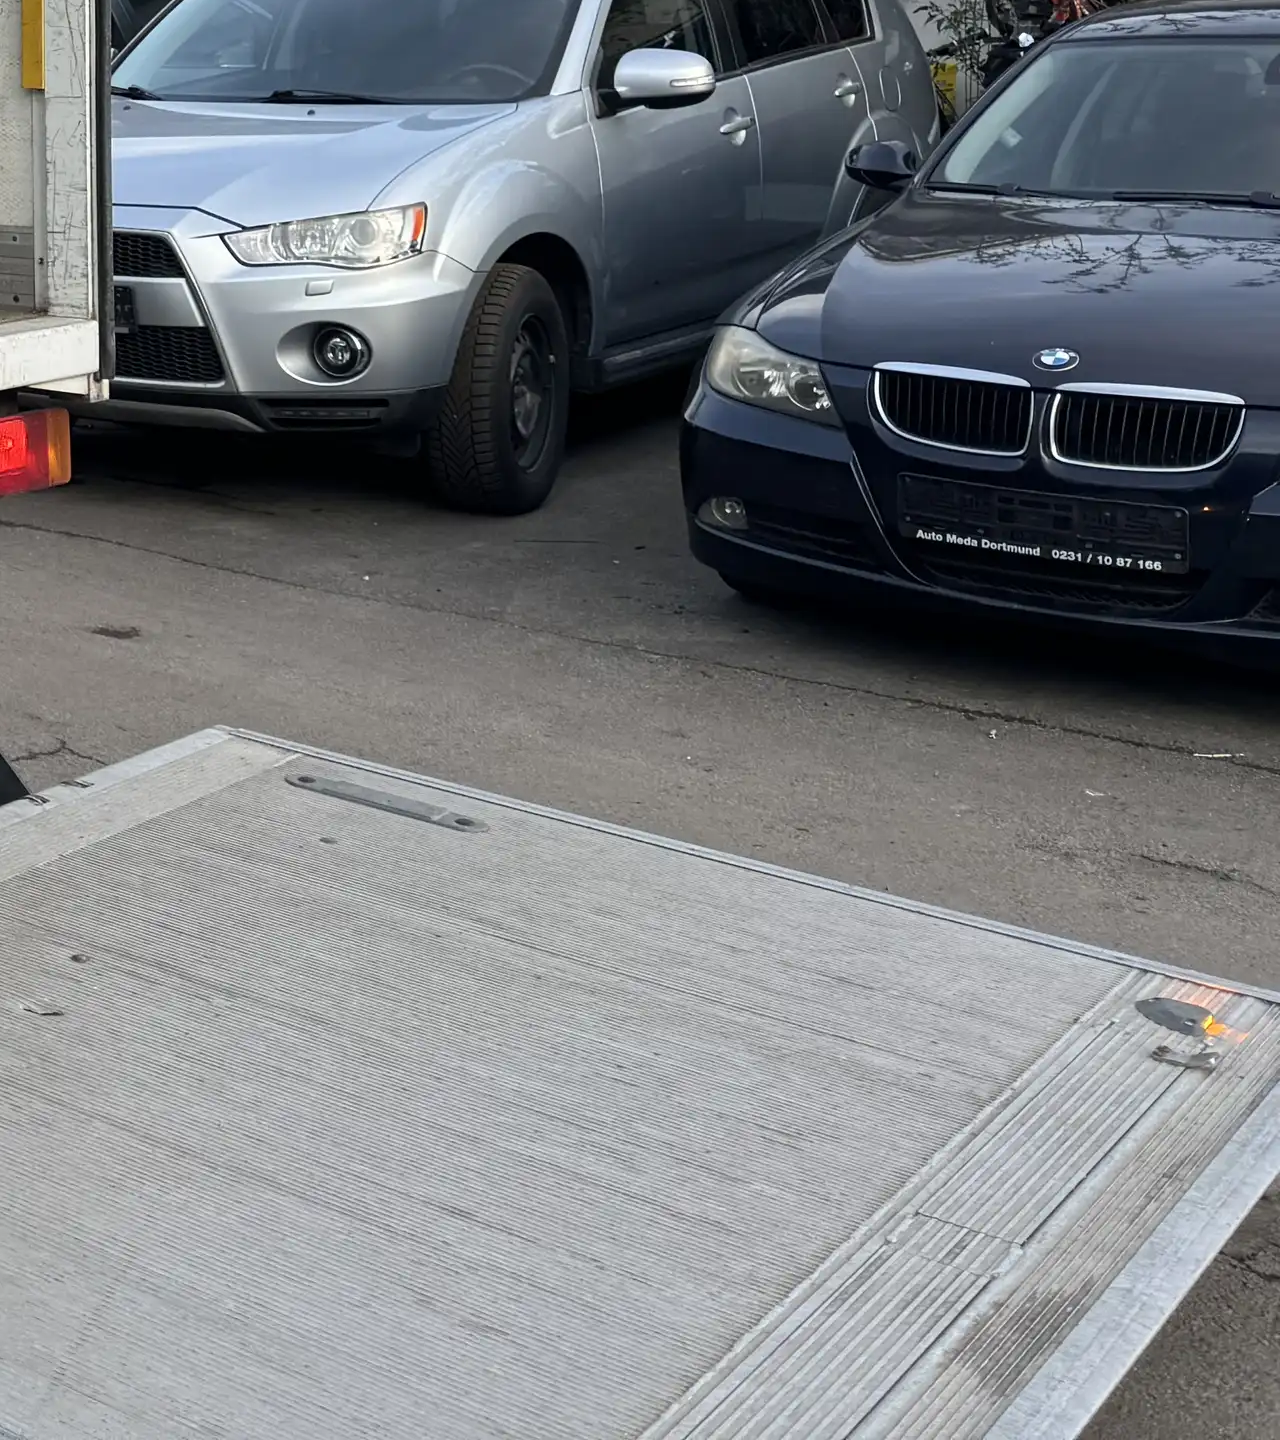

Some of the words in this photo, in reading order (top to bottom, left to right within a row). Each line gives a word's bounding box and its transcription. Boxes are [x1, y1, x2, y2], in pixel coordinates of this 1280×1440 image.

[916, 528, 943, 542] Auto
[946, 533, 978, 547] Meda
[981, 538, 1040, 557] Dortmund
[1051, 549, 1082, 562] 0231
[1097, 554, 1112, 566] 10
[1116, 557, 1132, 568] 87
[1137, 559, 1162, 571] 166
